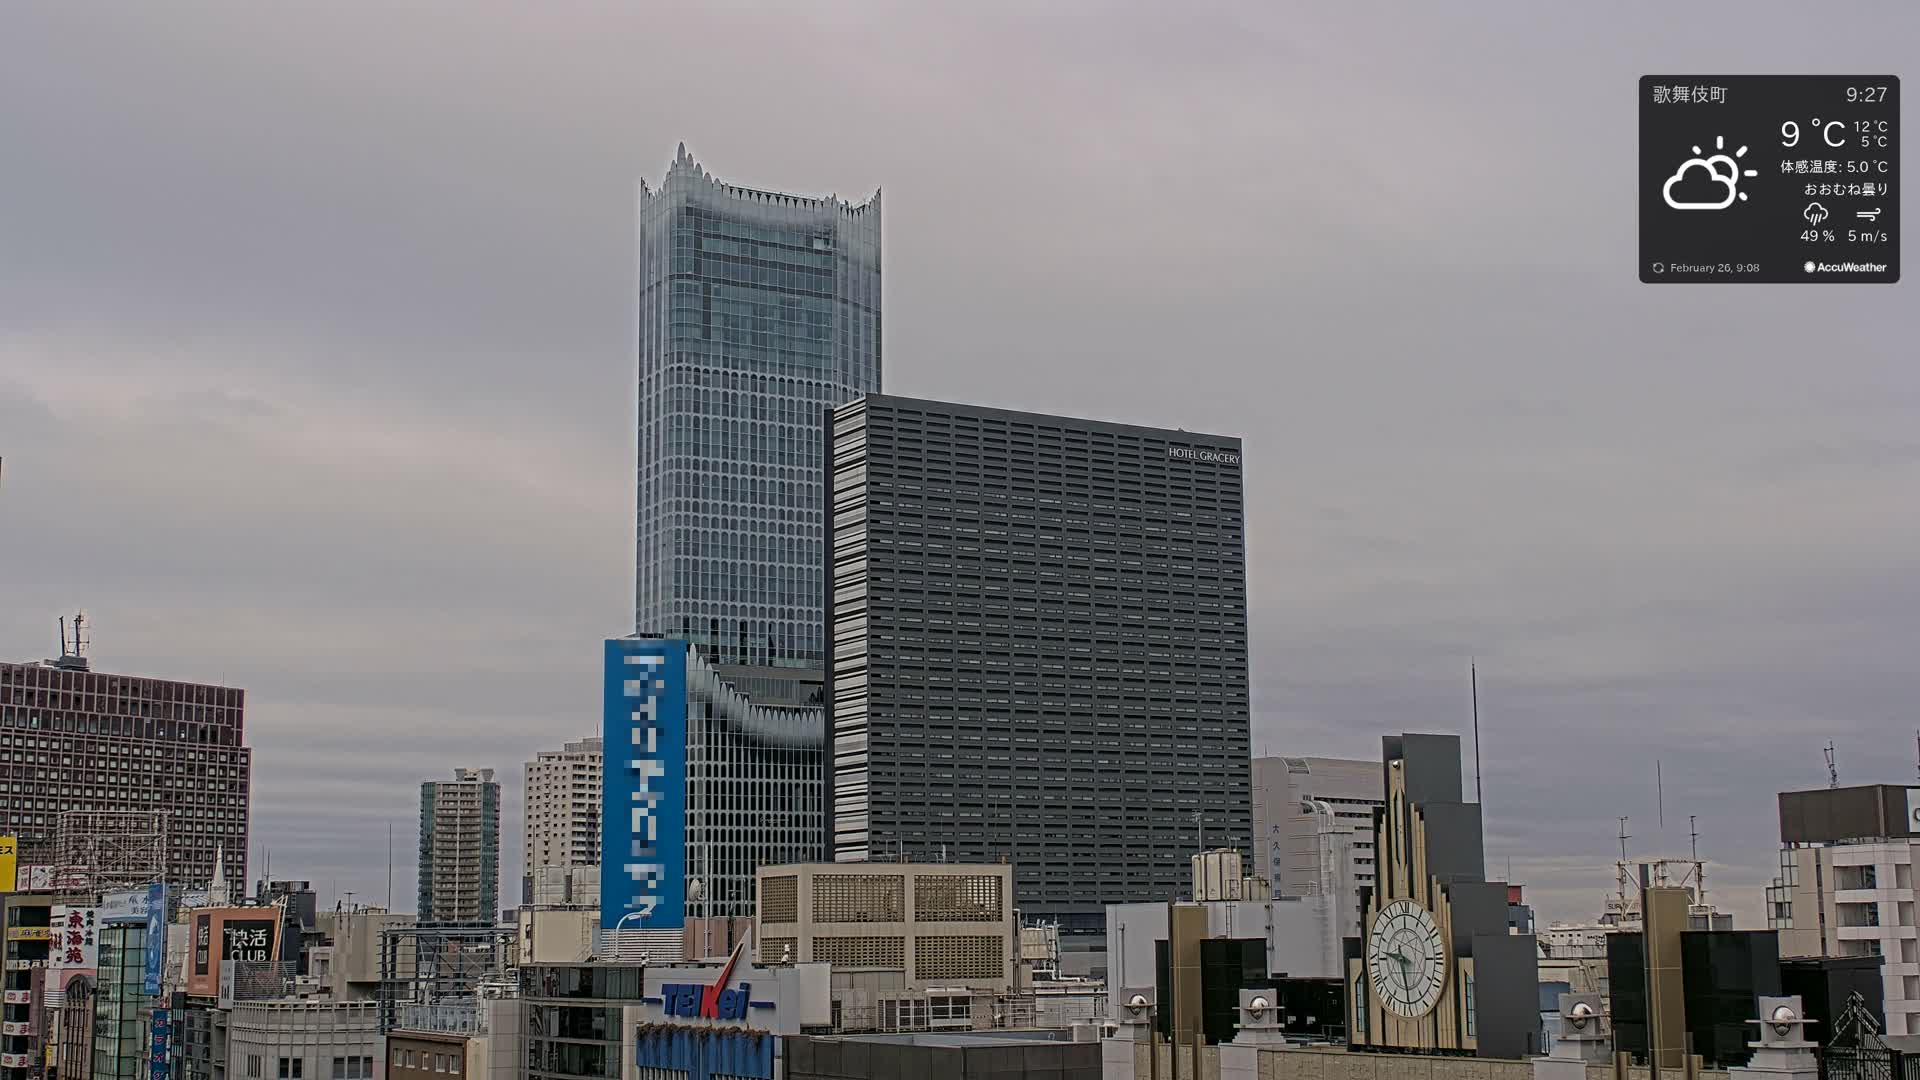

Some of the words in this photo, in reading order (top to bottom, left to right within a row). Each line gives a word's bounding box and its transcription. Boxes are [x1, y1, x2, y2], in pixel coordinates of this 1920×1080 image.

[1168, 447, 1199, 459] HOTEL
[1199, 451, 1241, 465] GRACERY
[64, 909, 85, 965] 東海苑
[231, 949, 267, 962] CLUB
